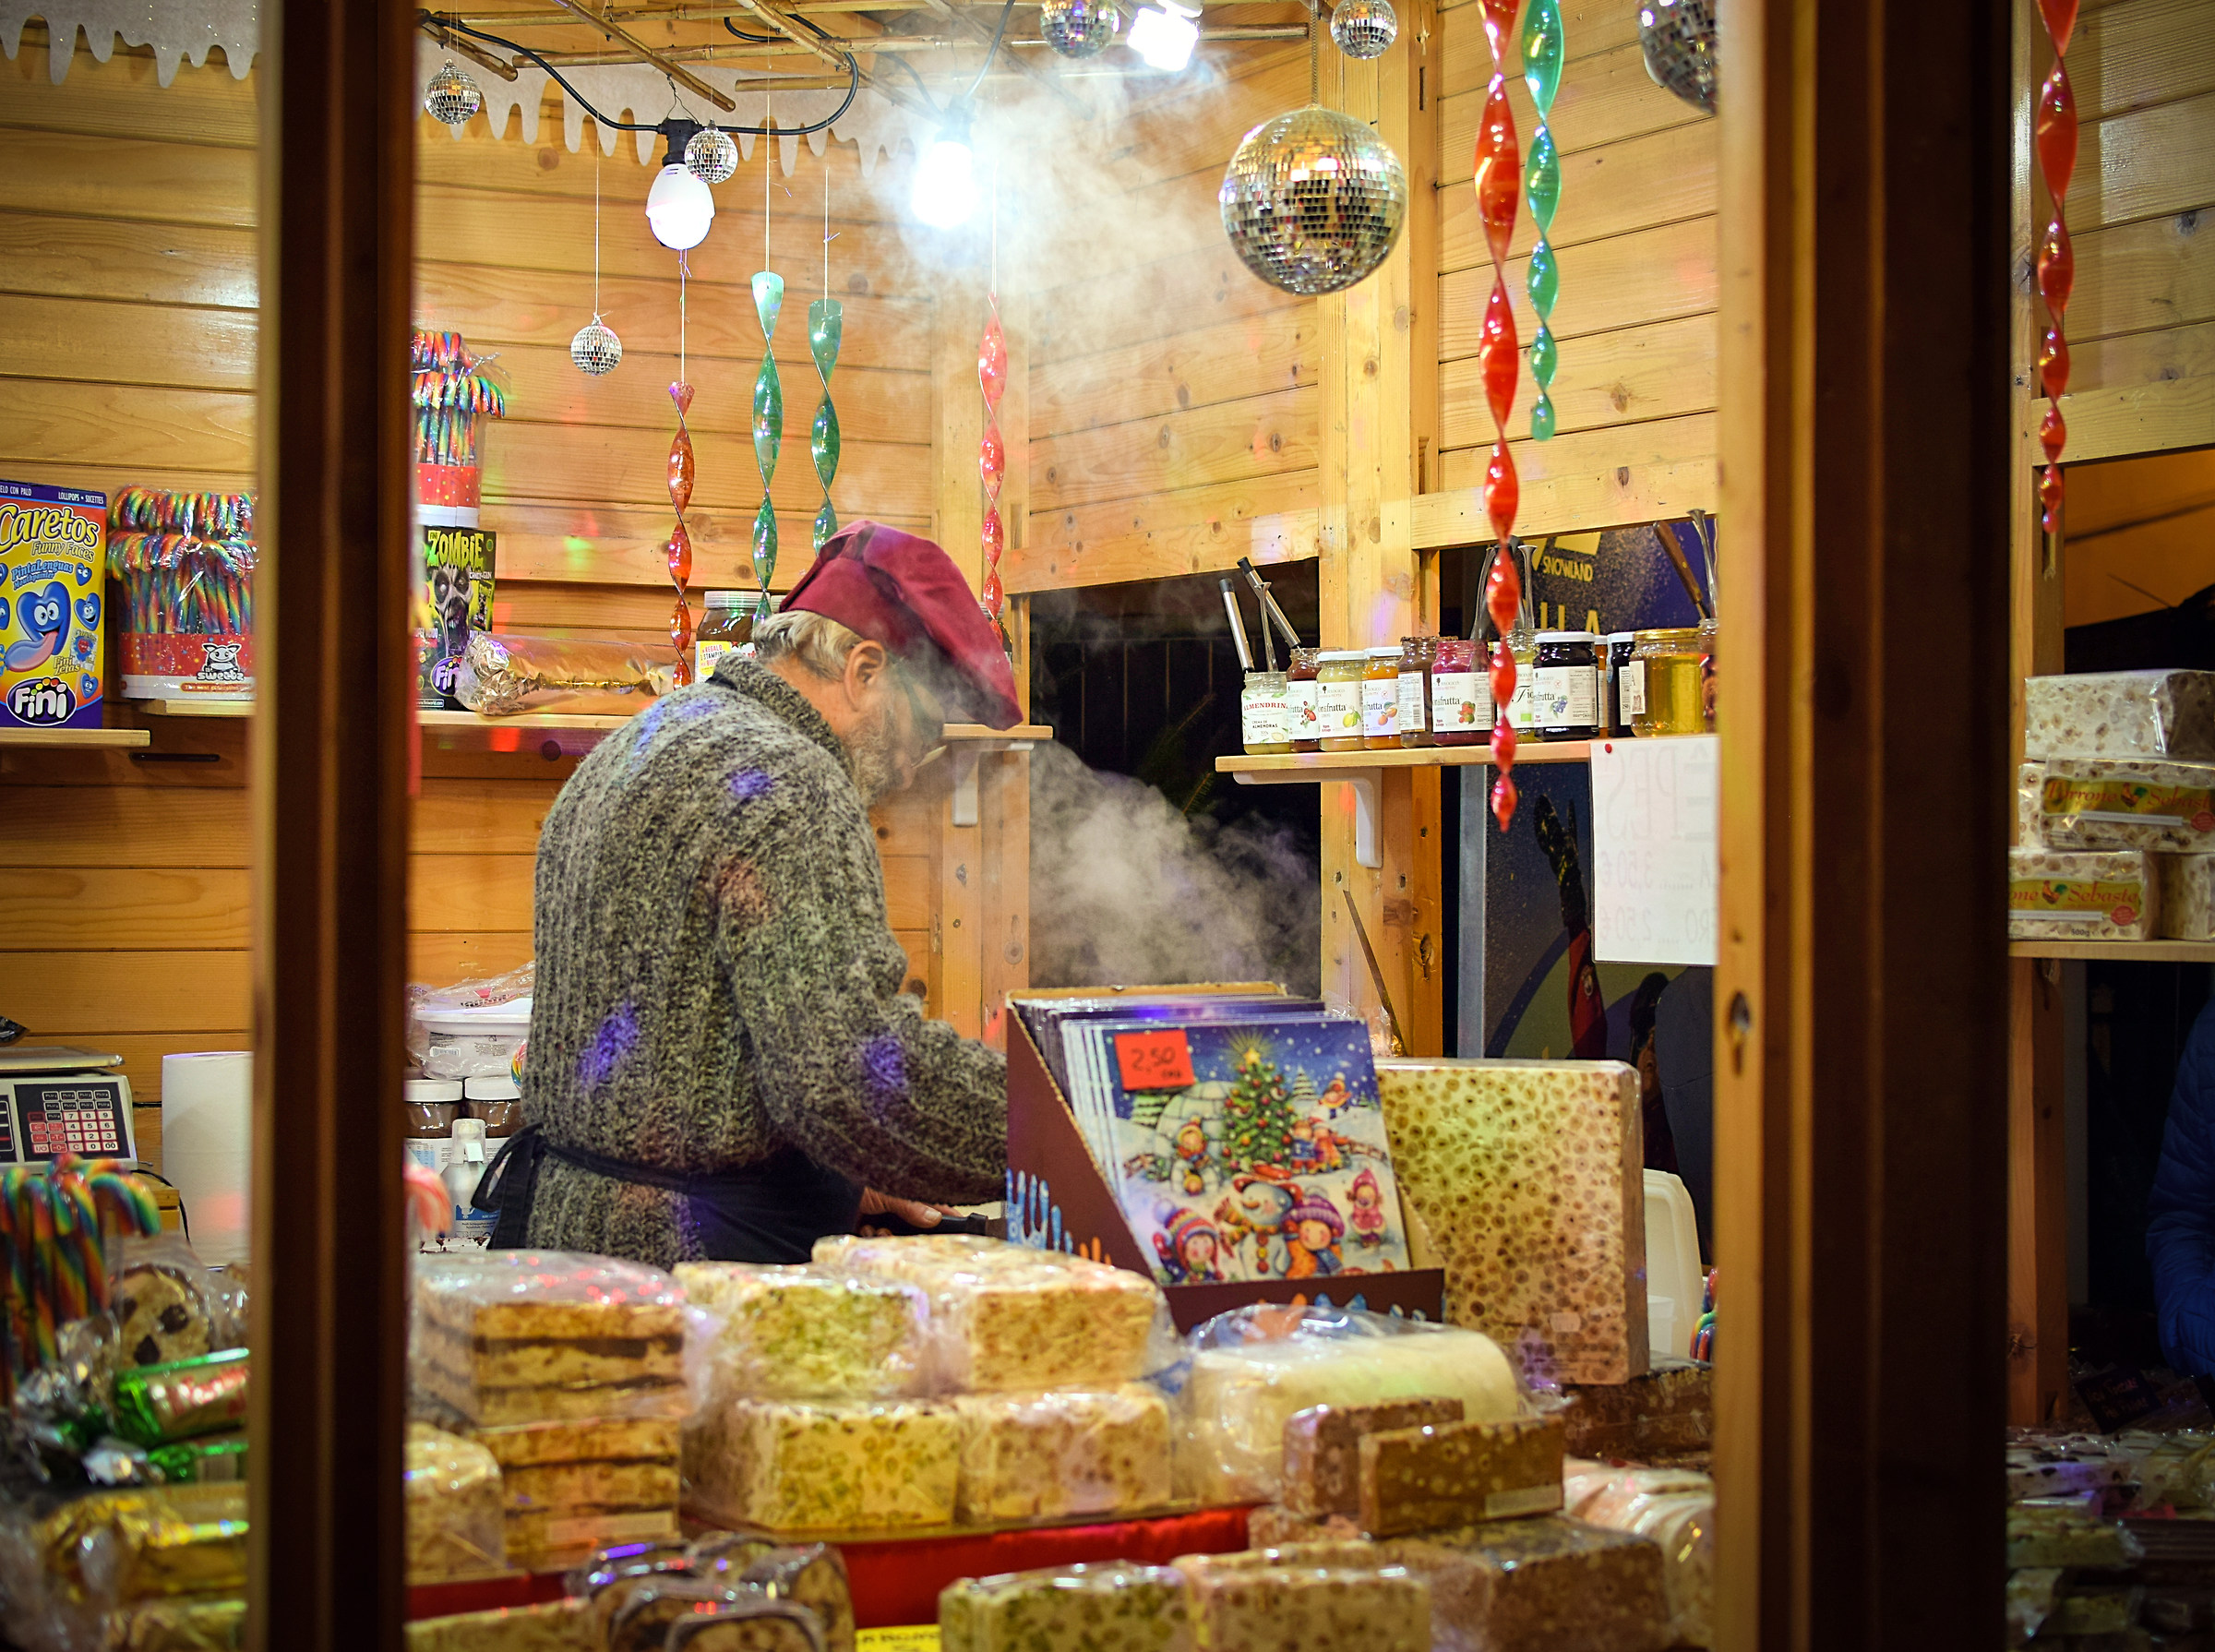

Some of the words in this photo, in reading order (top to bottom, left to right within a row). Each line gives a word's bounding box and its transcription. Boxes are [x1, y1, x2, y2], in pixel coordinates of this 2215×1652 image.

[10, 486, 19, 495] CON
[20, 487, 32, 497] PALO
[58, 492, 79, 502] LOLLIPOPS
[85, 495, 104, 505] SUCETTES
[0, 504, 100, 554] Caretos
[32, 541, 65, 556] Funny
[66, 541, 95, 563] Faces
[11, 559, 74, 581] PintaLenguas
[1542, 556, 1594, 582] SNOWLAND
[14, 572, 55, 591] Mouthpainter
[435, 664, 461, 691] Fin
[14, 684, 67, 719] Fini
[2045, 778, 2118, 804] Torrone
[2147, 785, 2212, 810] Sebast
[2067, 880, 2139, 904] Sebaste
[1131, 1047, 1176, 1074] 2,50
